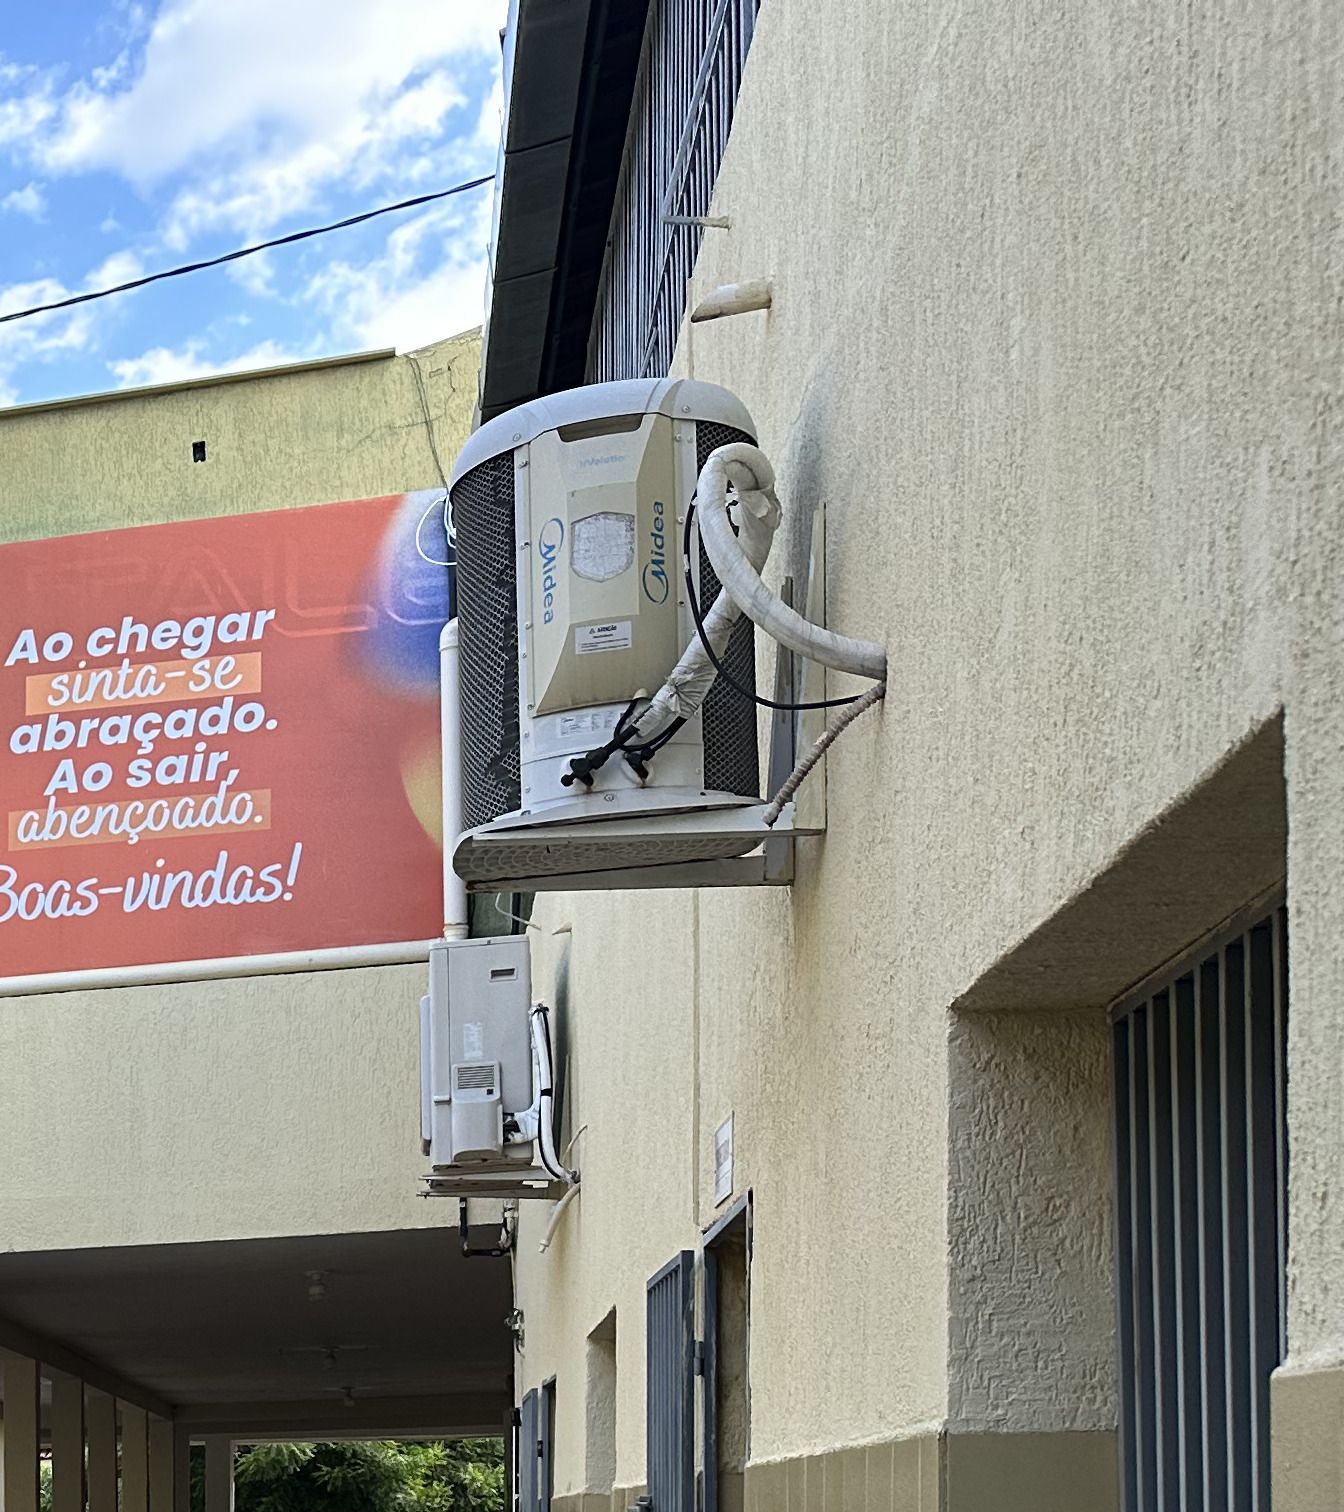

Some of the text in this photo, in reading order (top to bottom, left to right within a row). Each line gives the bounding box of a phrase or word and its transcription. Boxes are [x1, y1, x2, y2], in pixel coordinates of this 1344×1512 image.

[647, 500, 667, 590] Midea
[540, 533, 558, 625] Midea
[4, 608, 276, 667] Ao chegar
[47, 655, 243, 706] sinta-se
[9, 695, 278, 755] abraçado.
[43, 741, 240, 796] Ao sair,
[17, 779, 263, 845] abençoado.
